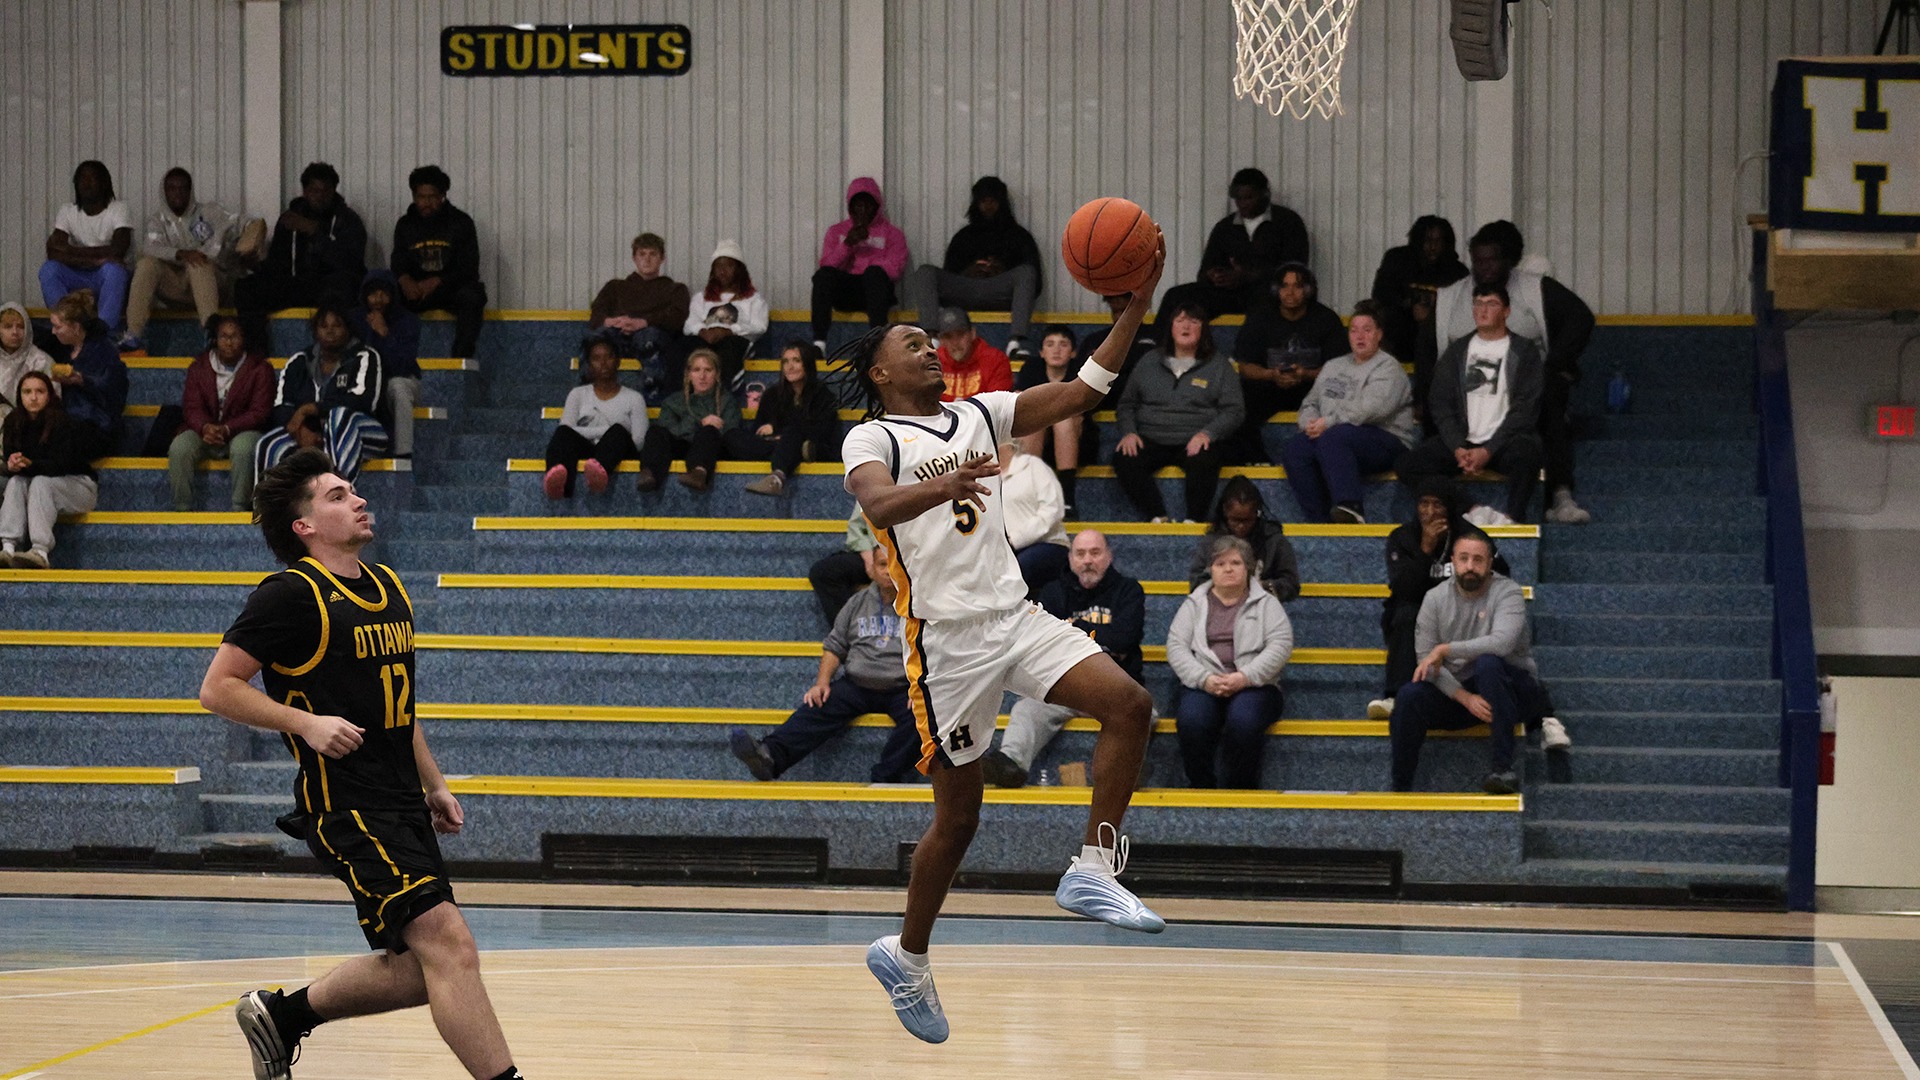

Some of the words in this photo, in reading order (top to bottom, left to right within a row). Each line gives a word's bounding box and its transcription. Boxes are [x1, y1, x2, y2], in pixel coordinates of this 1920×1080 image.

[449, 31, 685, 70] STUDENTS
[1803, 76, 1920, 215] H
[951, 499, 979, 536] 5
[354, 621, 415, 659] OTTAWA
[380, 663, 411, 729] 12
[949, 724, 974, 752] H
